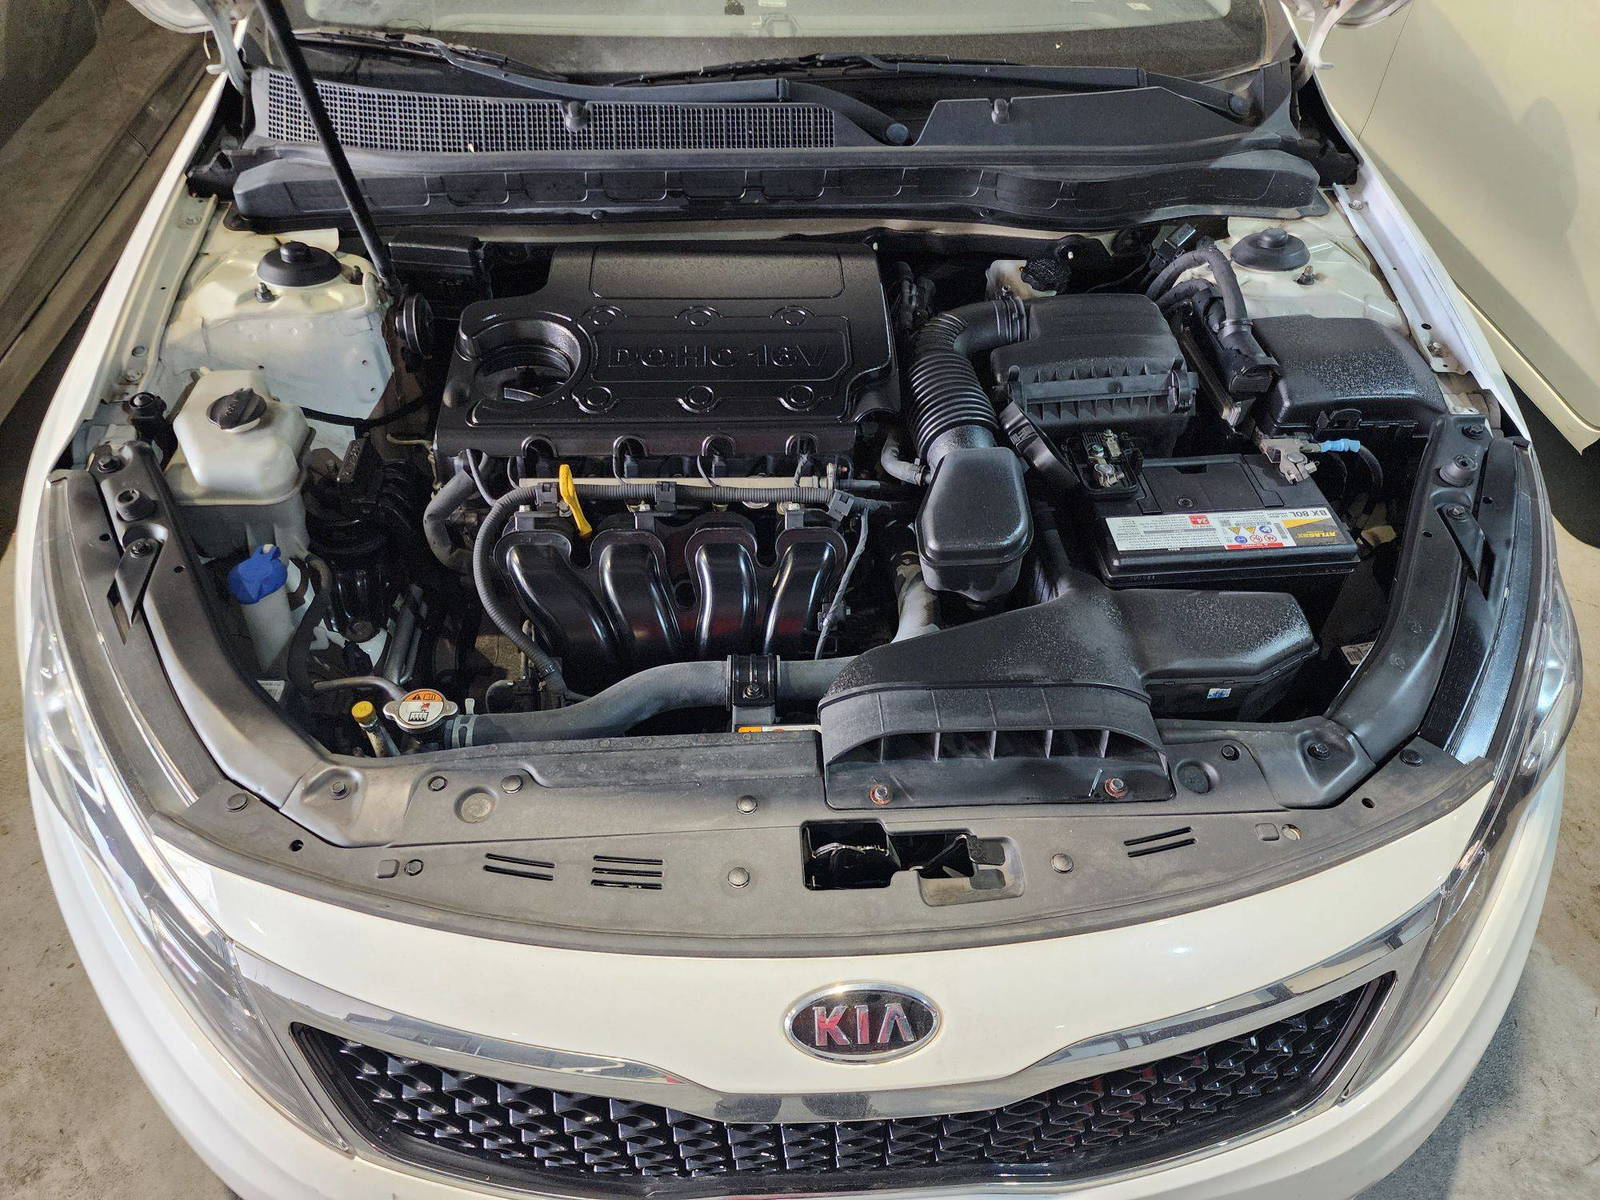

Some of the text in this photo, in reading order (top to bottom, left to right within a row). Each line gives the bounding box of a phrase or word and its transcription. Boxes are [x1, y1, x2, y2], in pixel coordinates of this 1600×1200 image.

[608, 343, 828, 368] DOHC 16V
[812, 1002, 916, 1047] KIA
